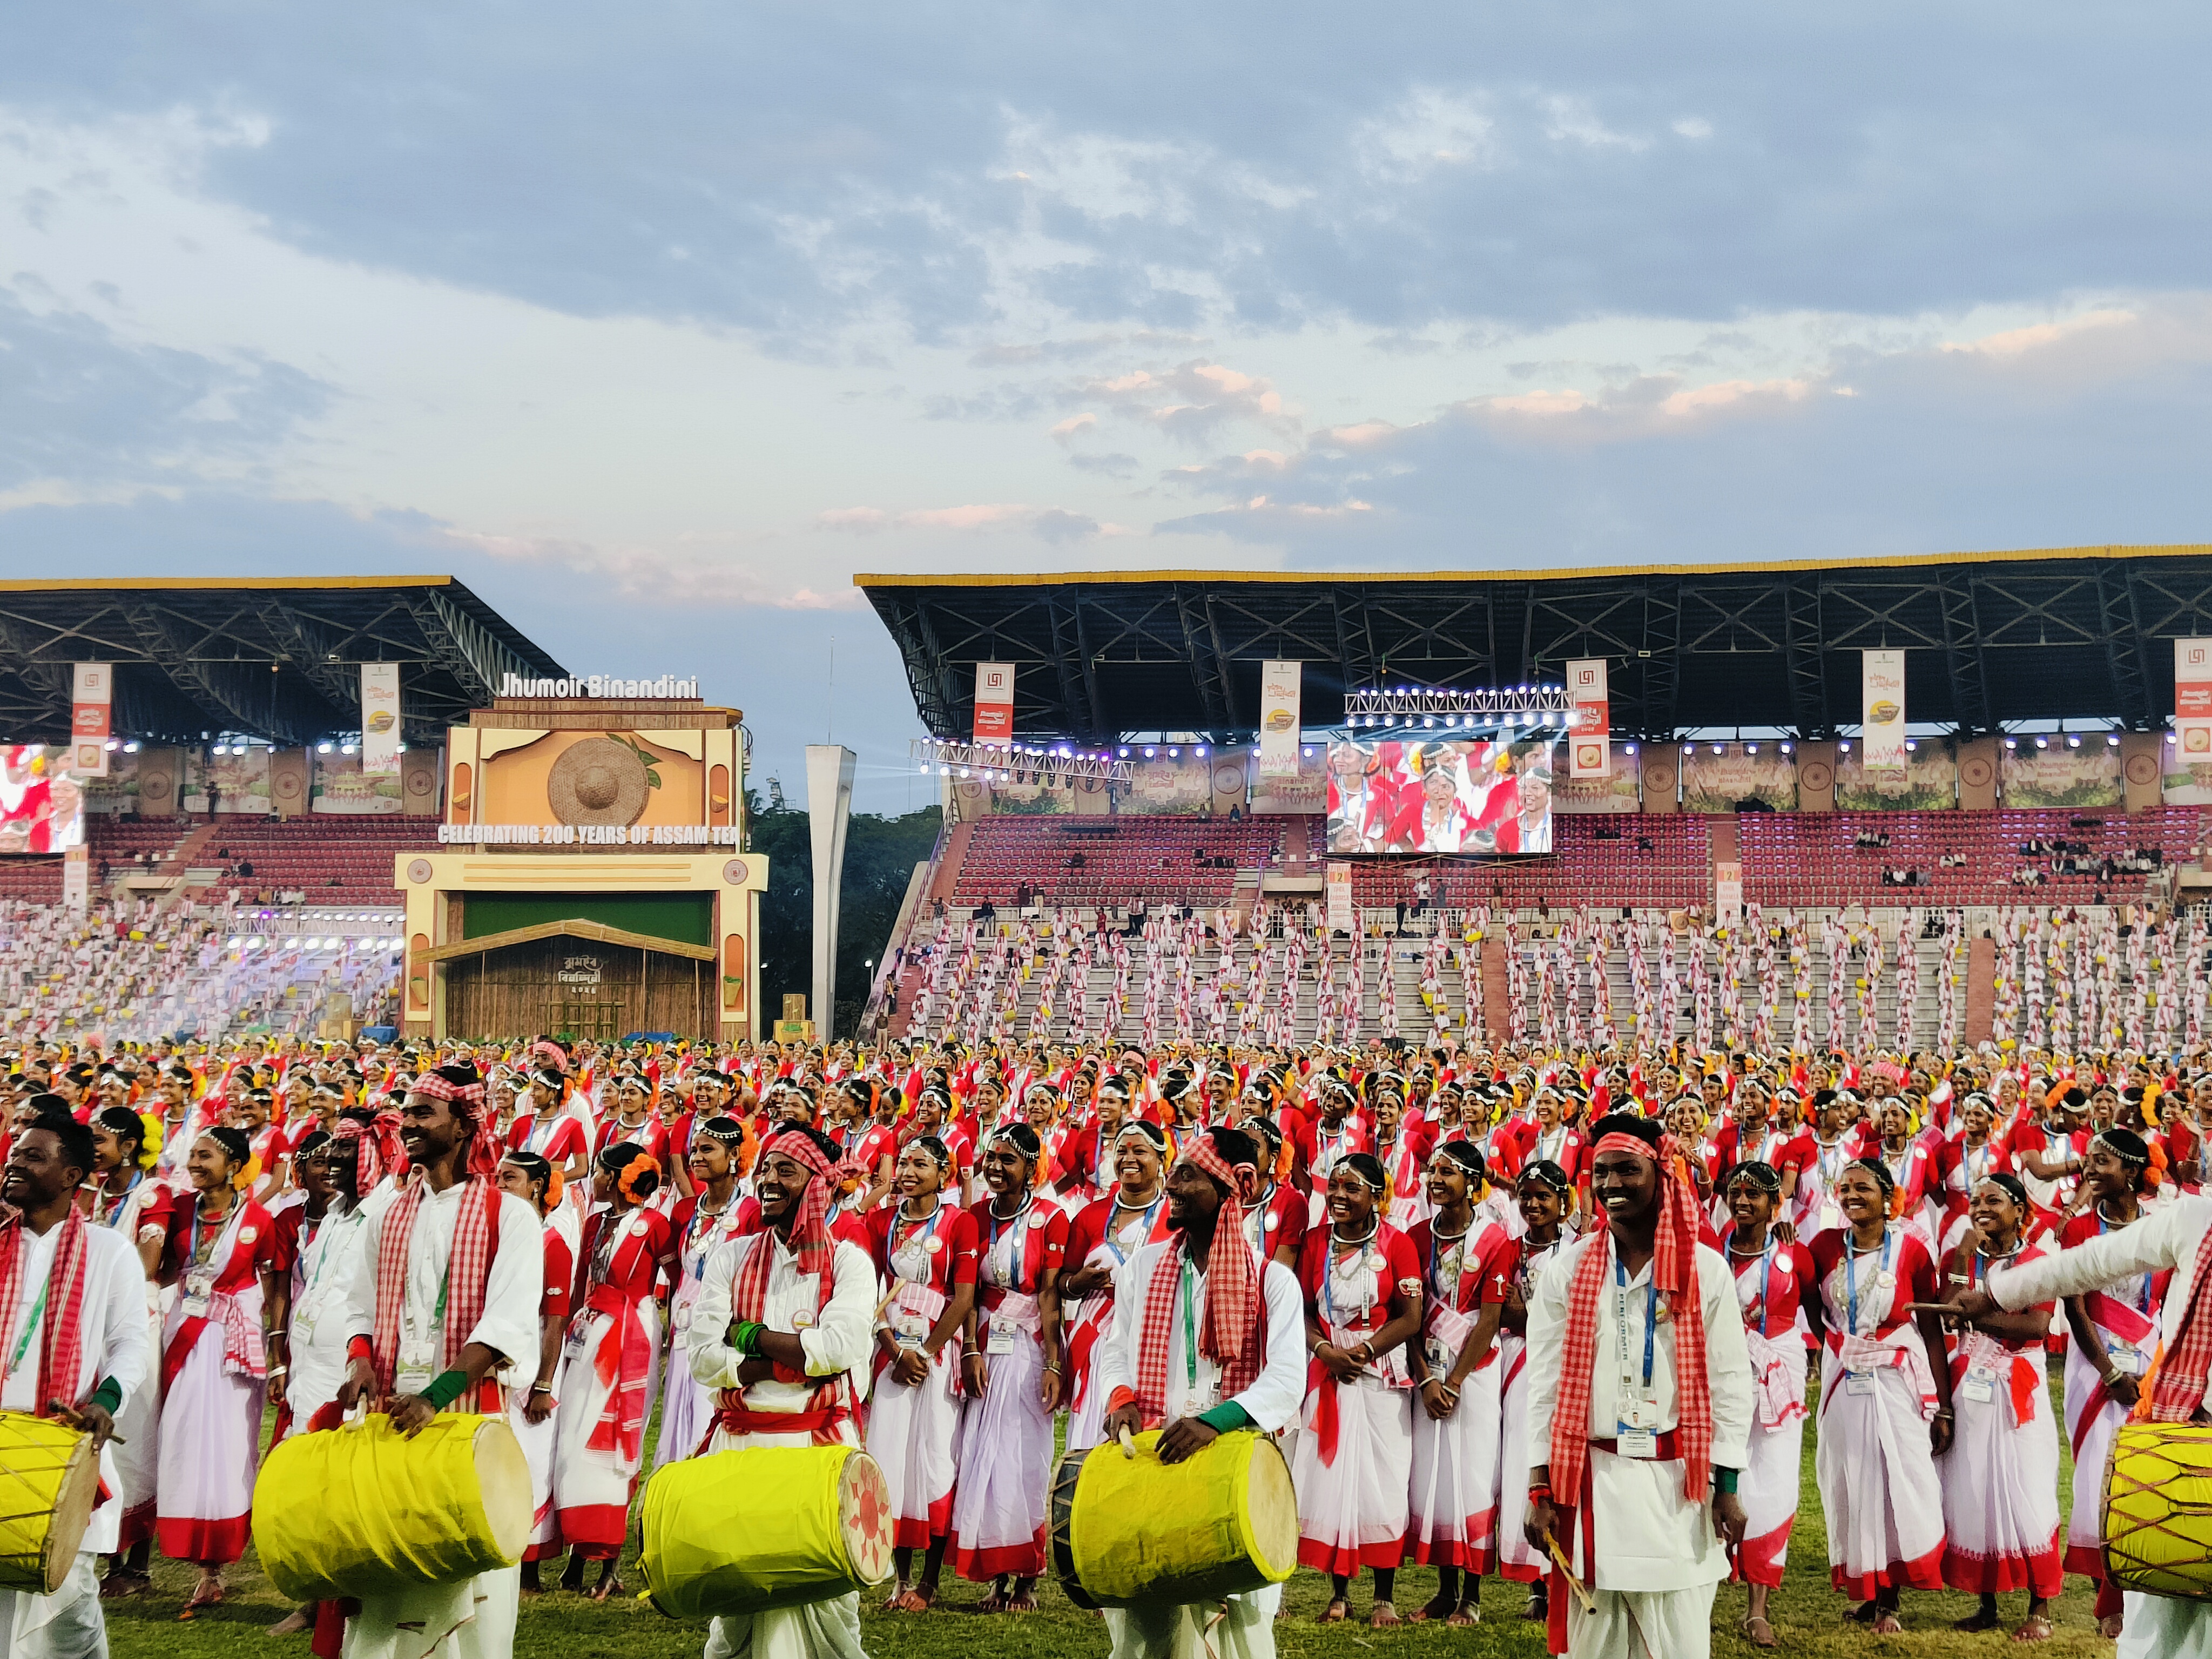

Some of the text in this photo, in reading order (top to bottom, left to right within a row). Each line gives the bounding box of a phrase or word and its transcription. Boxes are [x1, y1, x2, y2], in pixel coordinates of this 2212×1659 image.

[500, 672, 697, 699] Jhumoir Binandini
[438, 825, 740, 845] CELEBRATING 200 YEARS OF ASSAM TEA
[1337, 873, 1343, 882] 2
[1727, 871, 1732, 881] 2
[1619, 1293, 1628, 1360] PERFORMER
